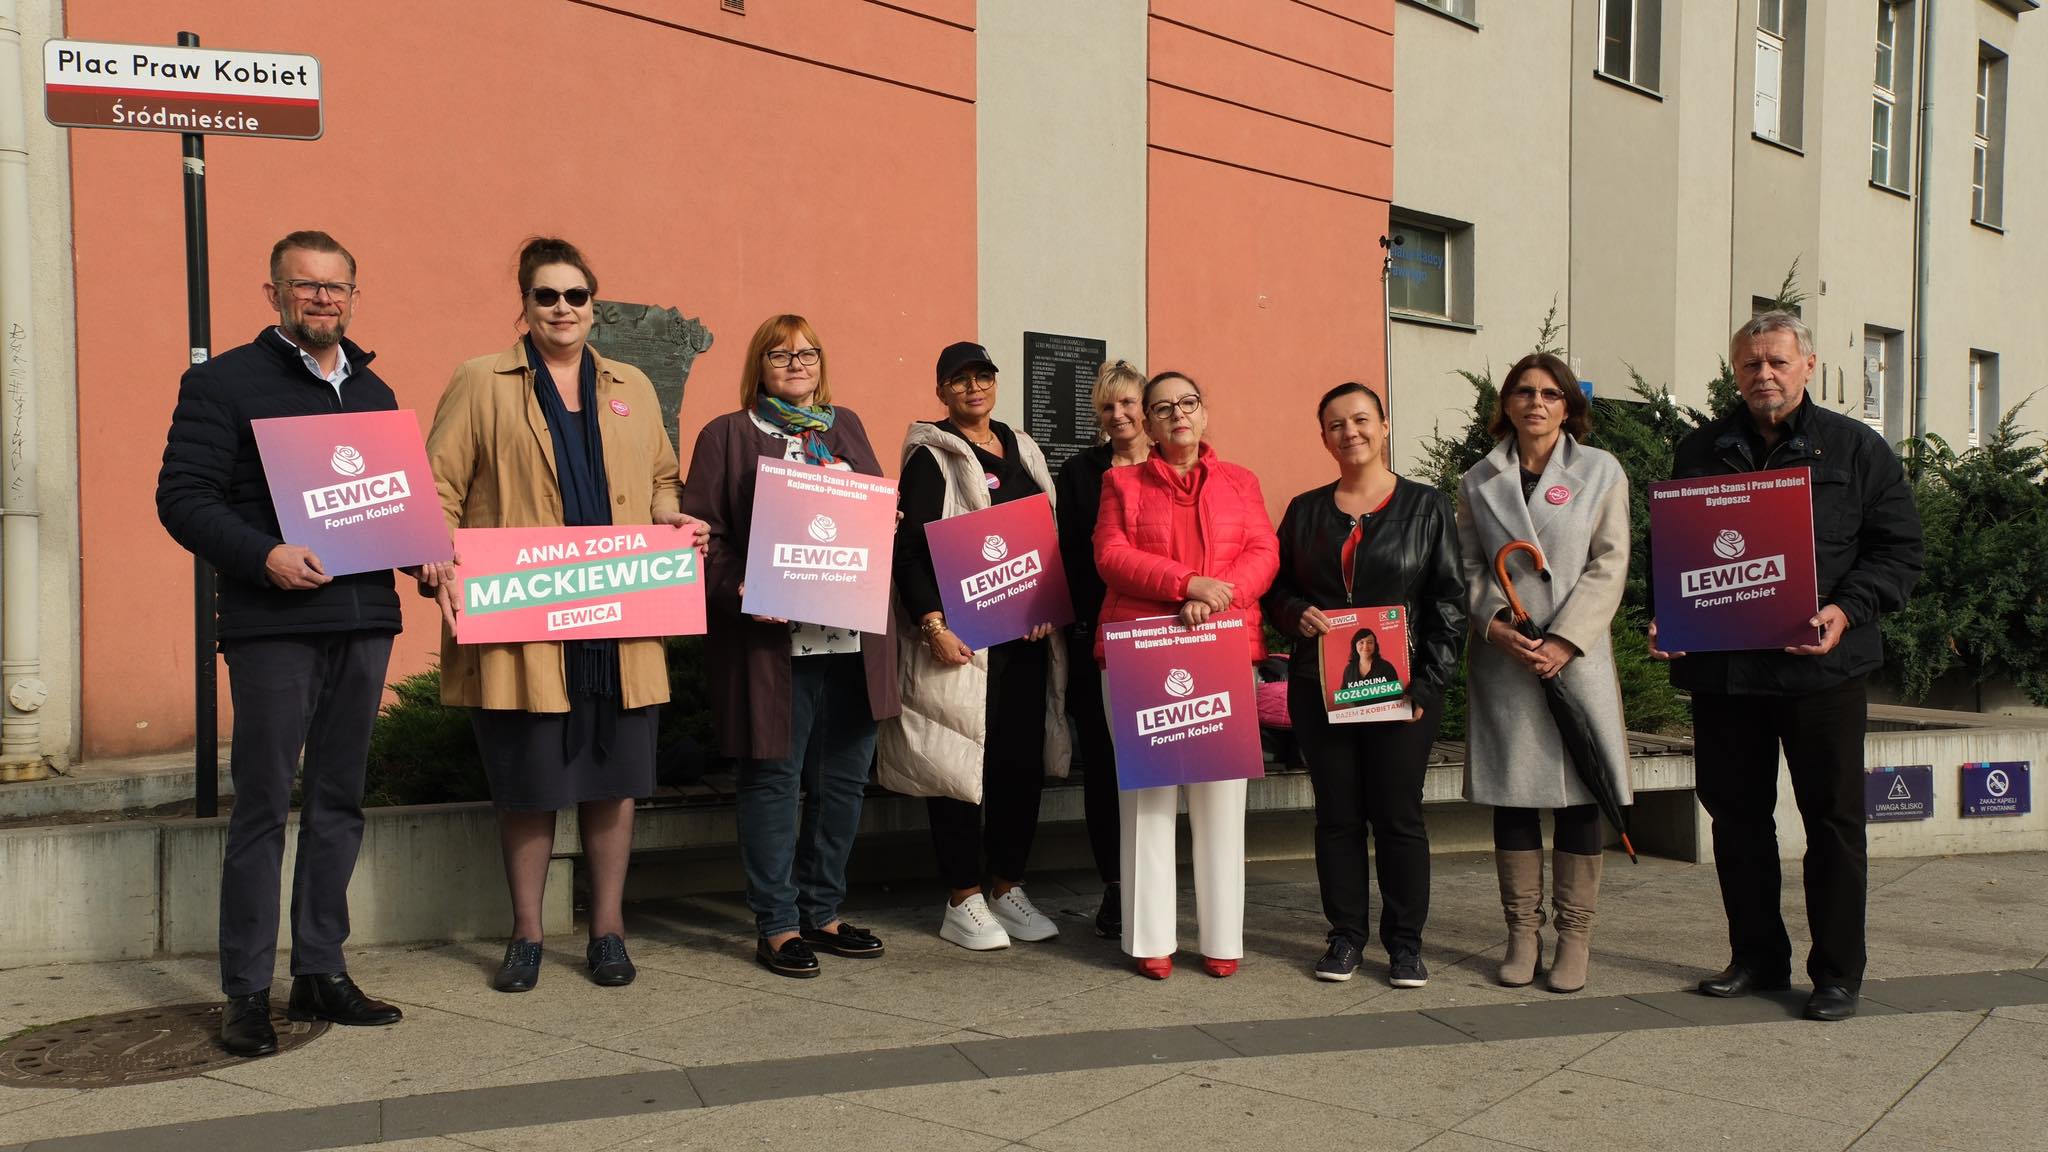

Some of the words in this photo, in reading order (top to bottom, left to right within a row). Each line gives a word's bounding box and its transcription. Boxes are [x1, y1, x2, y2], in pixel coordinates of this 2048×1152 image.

[58, 50, 118, 75] Plac
[133, 54, 200, 79] Praw
[215, 59, 307, 86] Kobiet
[112, 98, 259, 130] Śródmieście
[761, 463, 786, 476] Forum
[786, 468, 822, 483] Równych
[823, 475, 846, 487] Szans
[850, 479, 869, 491] Praw
[870, 483, 895, 495] Kobiet
[787, 479, 868, 501] Kujawsko-Pomorskie
[1653, 489, 1680, 499] Forum
[1681, 486, 1720, 498] Równych
[1720, 483, 1746, 493] Szans
[1752, 480, 1775, 490] Praw
[1775, 476, 1806, 488] Kobiet
[310, 476, 406, 513] LEWICA
[1706, 494, 1751, 507] Bydgoszcz
[324, 513, 364, 530] Forum
[366, 503, 405, 520] Kobiet
[515, 542, 580, 566] ANNA
[585, 532, 648, 556] ZOFIA
[779, 547, 863, 567] LEWICA
[470, 553, 693, 608] MACKIEWICZ
[783, 570, 819, 581] Forum
[821, 571, 857, 583] Kobiet
[966, 556, 1038, 597] LEWICA
[1687, 560, 1781, 593] LEWICA
[976, 592, 1006, 611] Forum
[1007, 578, 1038, 598] Kobiet
[1695, 595, 1733, 609] Forum
[1735, 586, 1777, 602] Kobiet
[551, 605, 618, 627] LEWICA
[1390, 610, 1397, 619] 3
[1106, 629, 1131, 641] Forum
[1132, 625, 1168, 638] Równych
[1168, 625, 1187, 634] Szan
[1196, 622, 1217, 631] Praw
[1217, 618, 1243, 629] Kobiet
[1135, 633, 1217, 649] Kujawsko-Pomorskie
[1334, 682, 1402, 702] KOZŁOWSKA
[1347, 676, 1387, 689] KAROLINA
[1142, 697, 1227, 731] LEWICA
[1151, 732, 1185, 746] Forum
[1187, 722, 1224, 738] Kobiet
[1875, 803, 1900, 811] UWAGA
[1900, 801, 1924, 810] ŚLISKO
[1986, 804, 2017, 812] FONTANNIE
